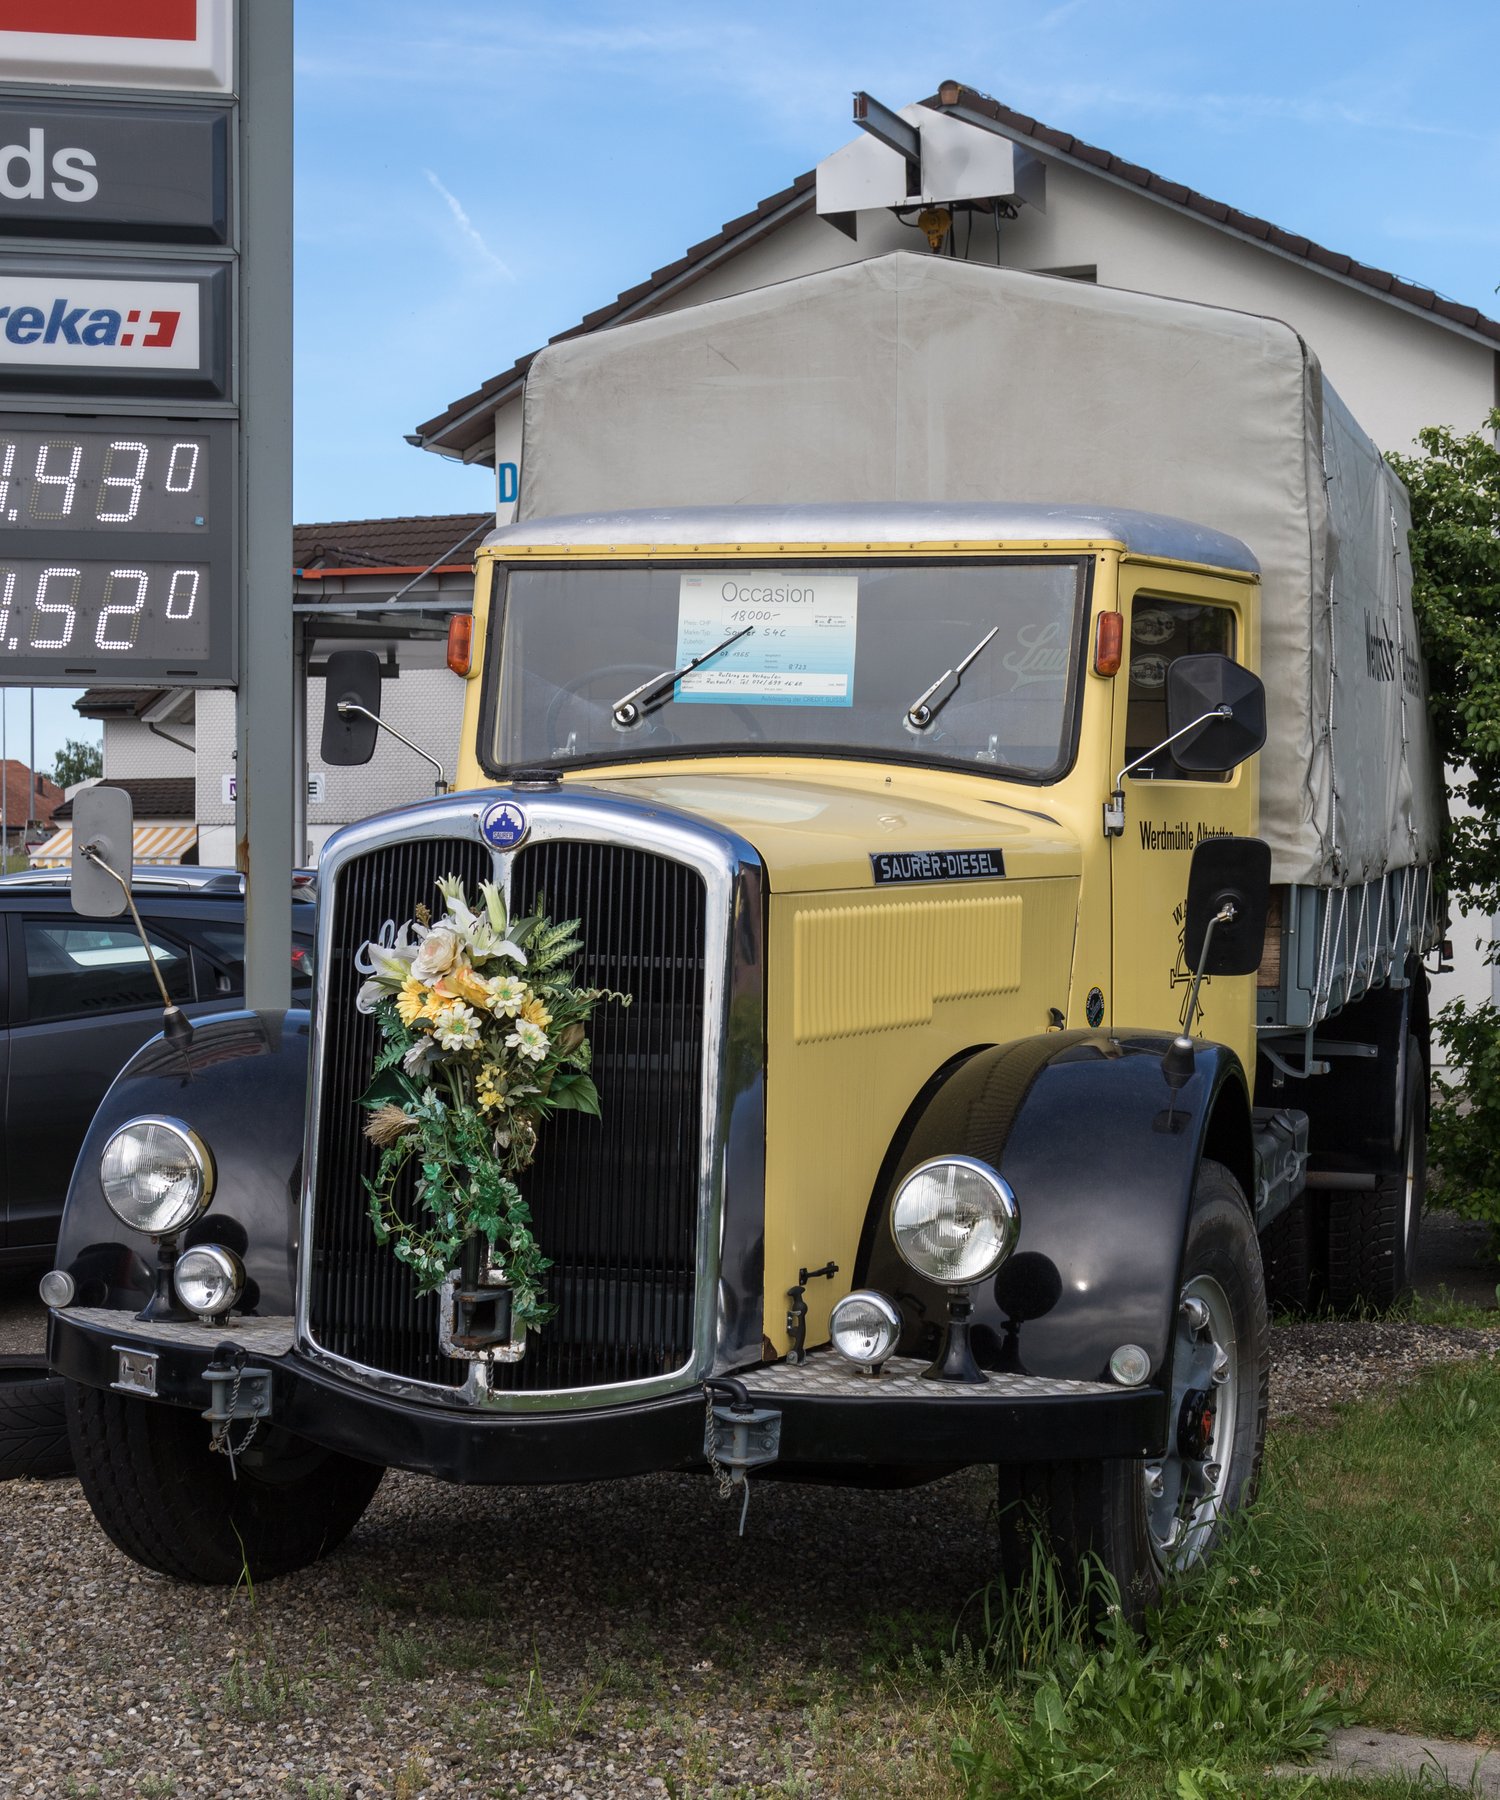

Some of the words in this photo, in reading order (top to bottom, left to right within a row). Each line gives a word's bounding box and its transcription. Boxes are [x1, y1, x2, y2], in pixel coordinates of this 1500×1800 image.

[0, 128, 98, 203] ds
[721, 582, 815, 603] Occasion
[724, 626, 756, 637] Saer
[1139, 820, 1194, 850] Werdmühle
[880, 853, 998, 879] SAURER-DIESEL
